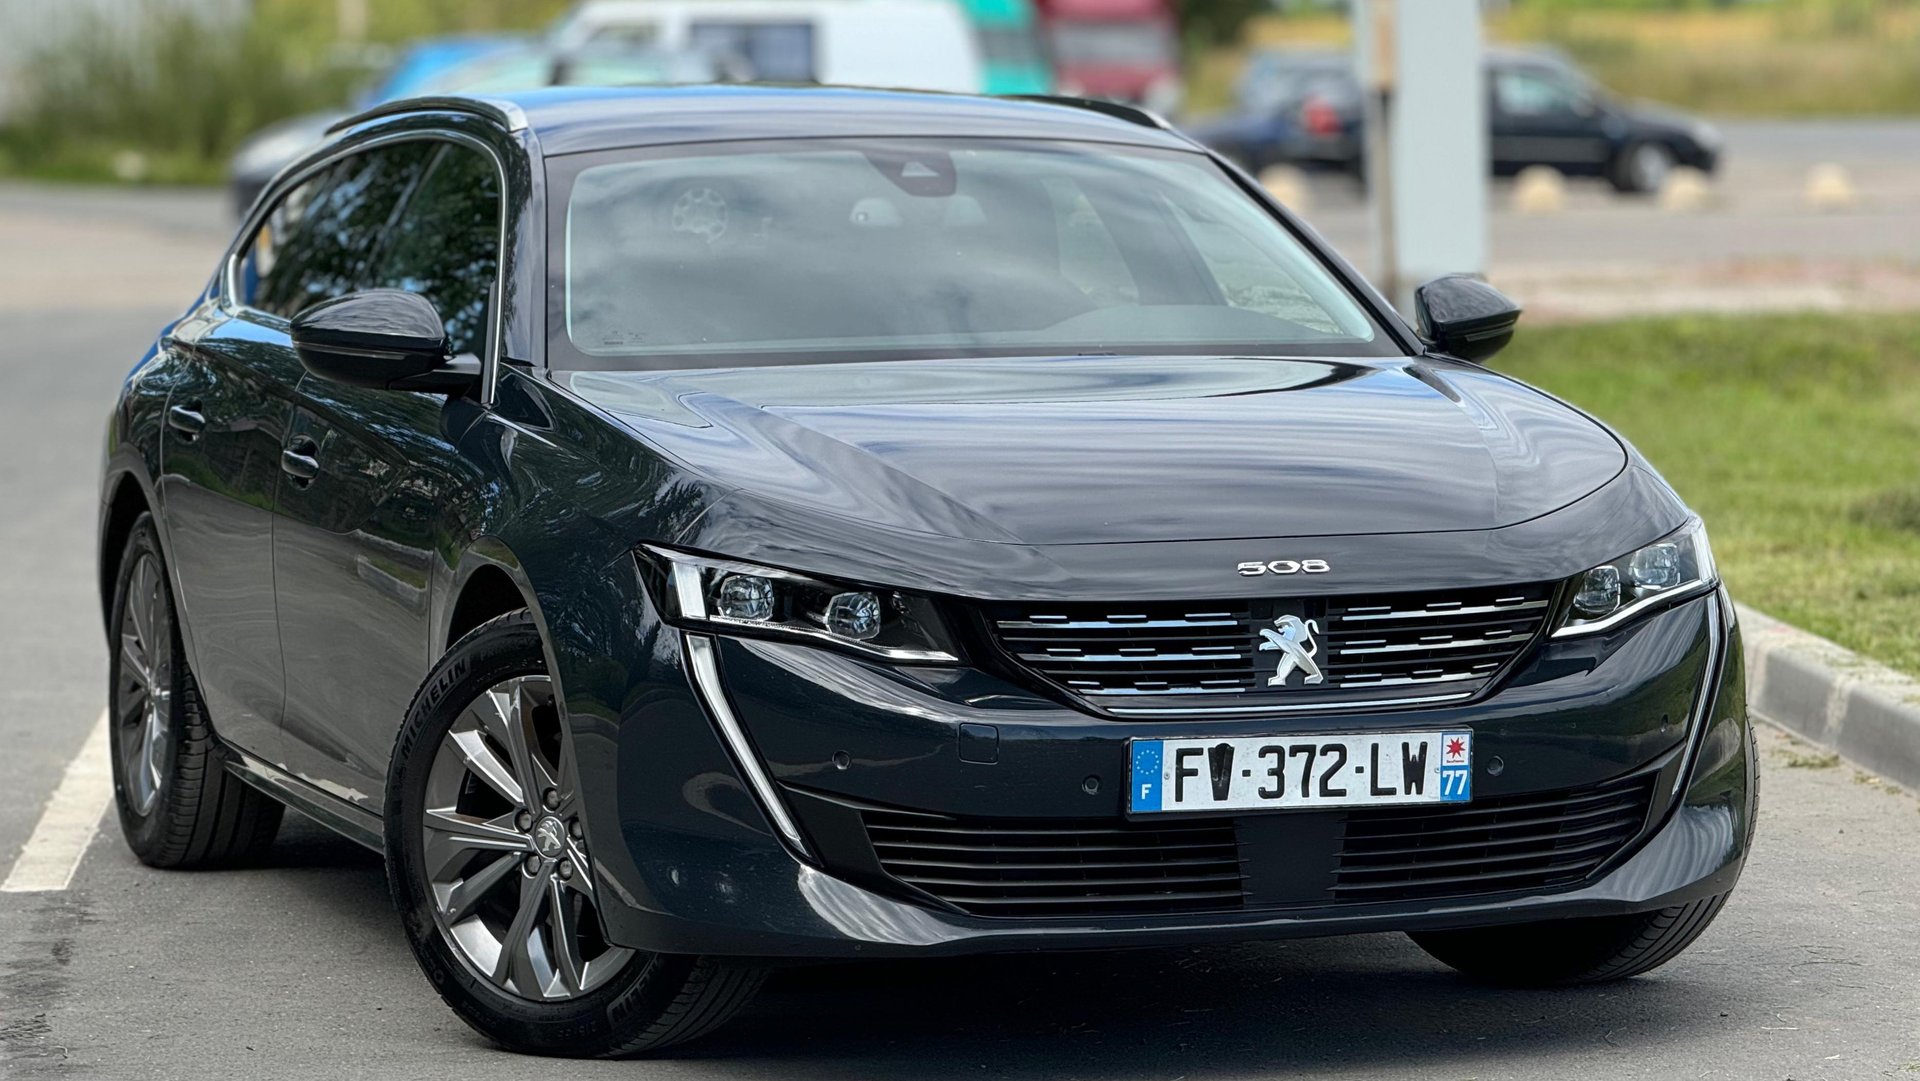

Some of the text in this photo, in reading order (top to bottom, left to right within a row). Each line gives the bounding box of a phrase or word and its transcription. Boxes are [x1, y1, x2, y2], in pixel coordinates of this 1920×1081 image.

[1237, 559, 1331, 577] 508
[401, 659, 467, 760] MICHELIN
[1141, 783, 1152, 800] F
[1442, 770, 1468, 796] 77
